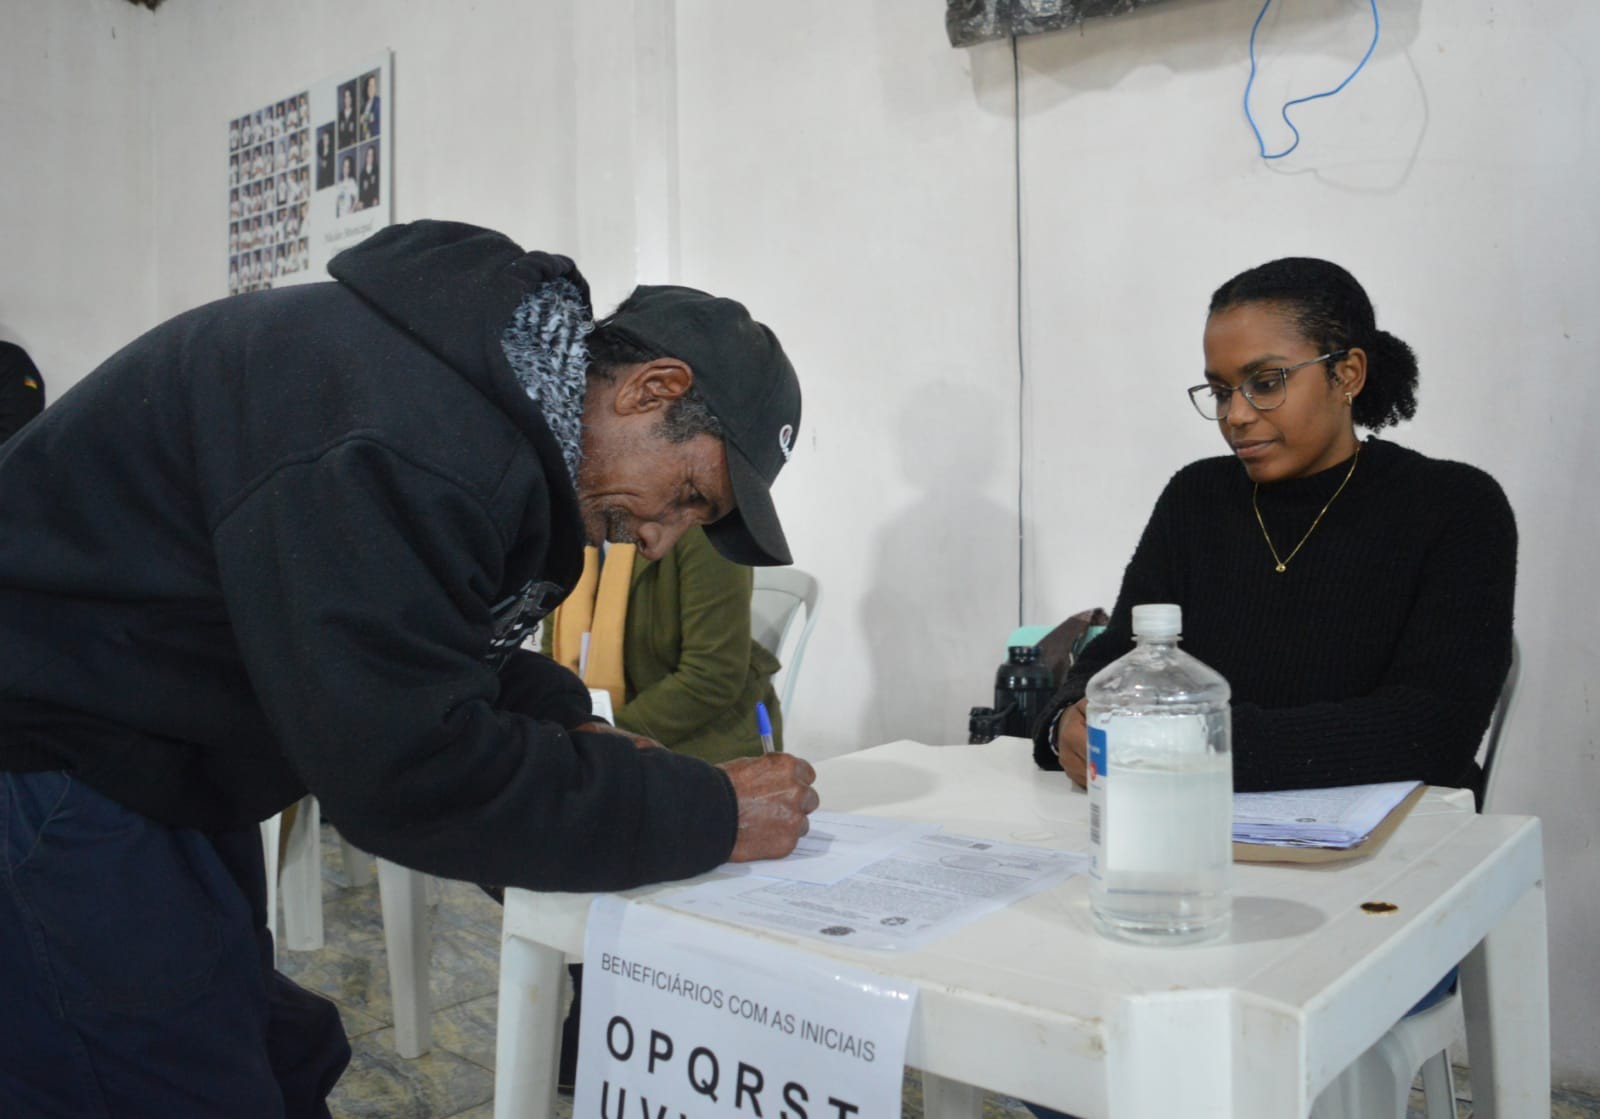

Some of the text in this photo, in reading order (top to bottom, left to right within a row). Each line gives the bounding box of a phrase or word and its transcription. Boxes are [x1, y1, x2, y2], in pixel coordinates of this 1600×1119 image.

[601, 952, 876, 1063] BENEFICIÁRIOS COM AS INICIAIS
